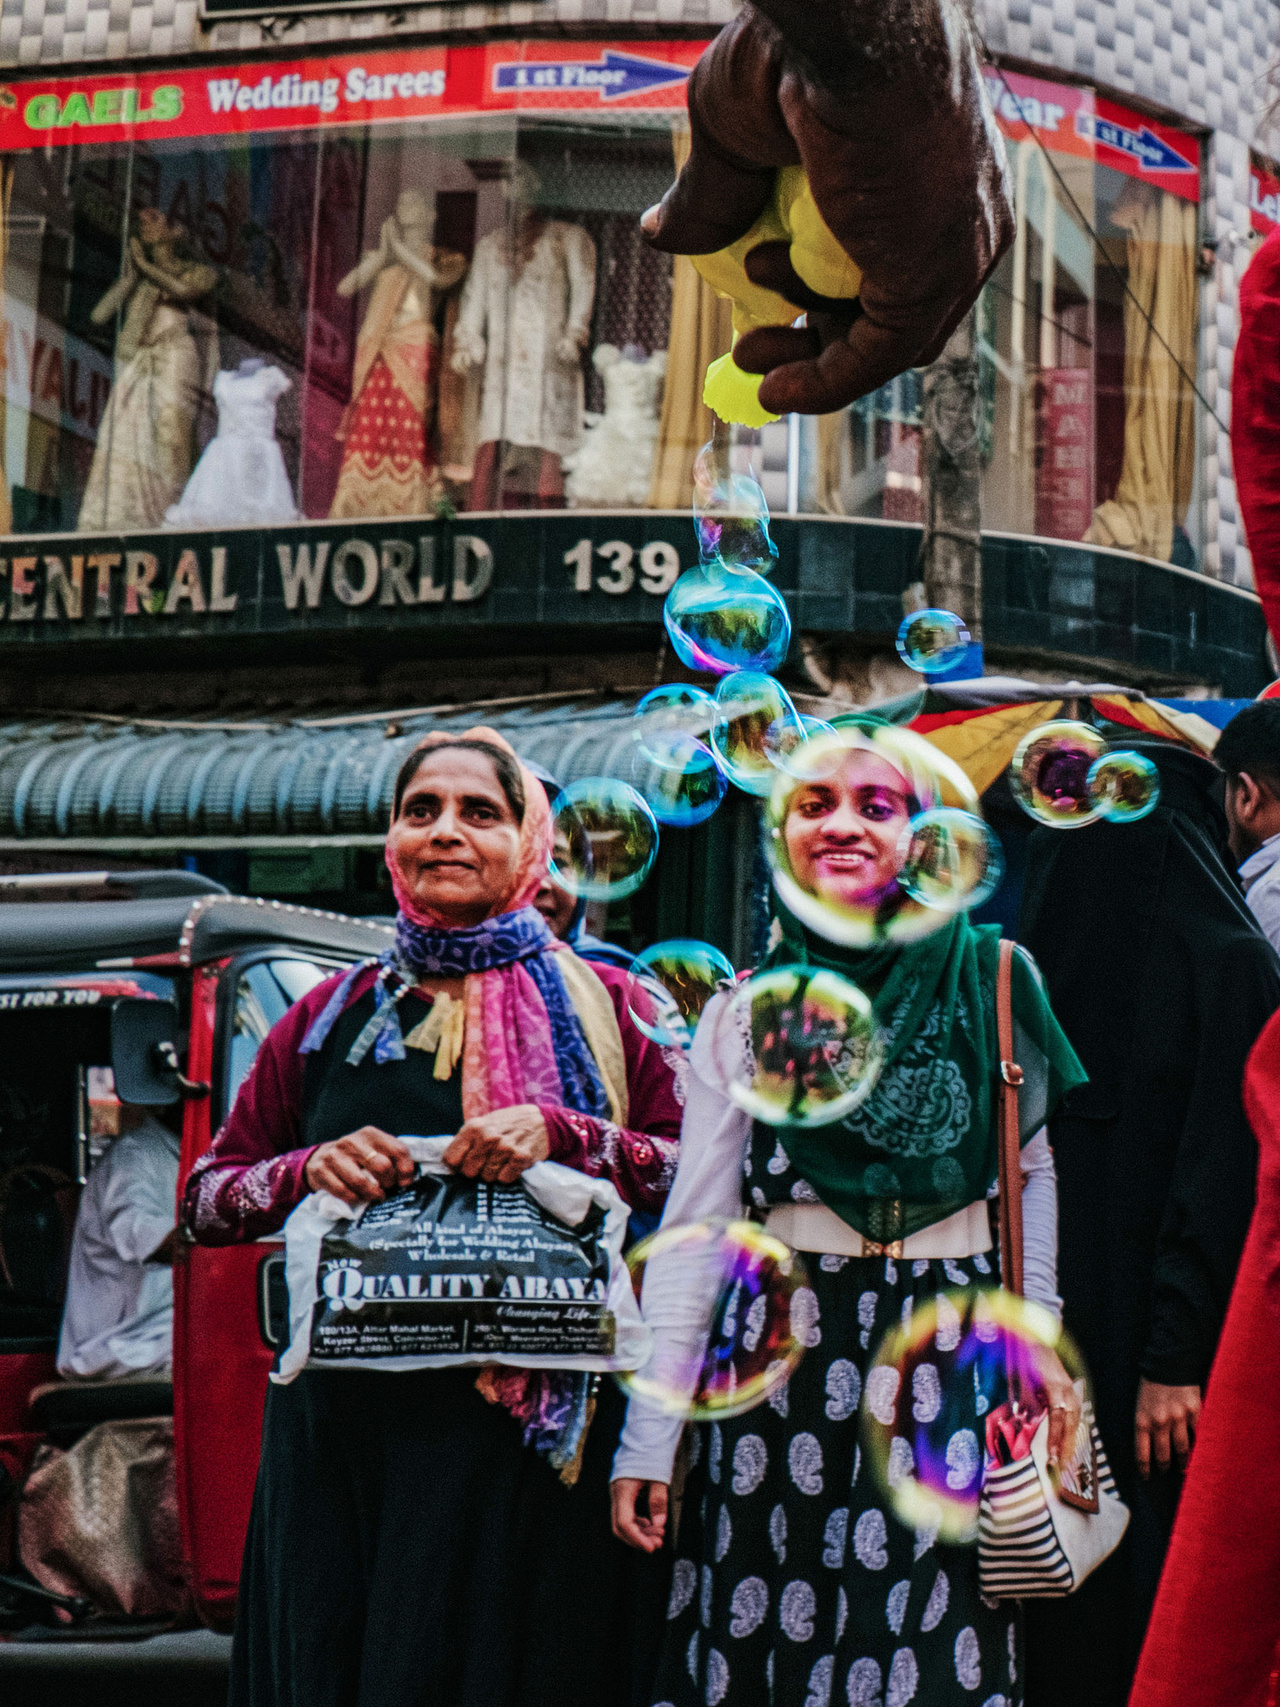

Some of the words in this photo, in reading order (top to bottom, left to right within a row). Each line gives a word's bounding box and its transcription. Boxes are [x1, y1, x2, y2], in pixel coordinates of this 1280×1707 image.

[561, 65, 627, 86] Floor
[206, 72, 340, 114] Wedding
[344, 66, 446, 103] Sarees
[24, 85, 184, 130] GAELS
[276, 535, 494, 610] WORLD
[564, 539, 680, 595] 139
[22, 990, 58, 1008] FOR
[63, 989, 101, 1005] YOU
[411, 1221, 432, 1234] All
[435, 1222, 466, 1235] kind
[469, 1223, 483, 1235] of
[487, 1224, 533, 1237] Abayas
[369, 1234, 434, 1251] (Specially
[437, 1235, 459, 1247] for
[461, 1234, 520, 1250] Wedding
[407, 1248, 477, 1262] Wholesale
[479, 1250, 493, 1262] &
[496, 1249, 535, 1263] Retail
[322, 1267, 491, 1312] QUALITY
